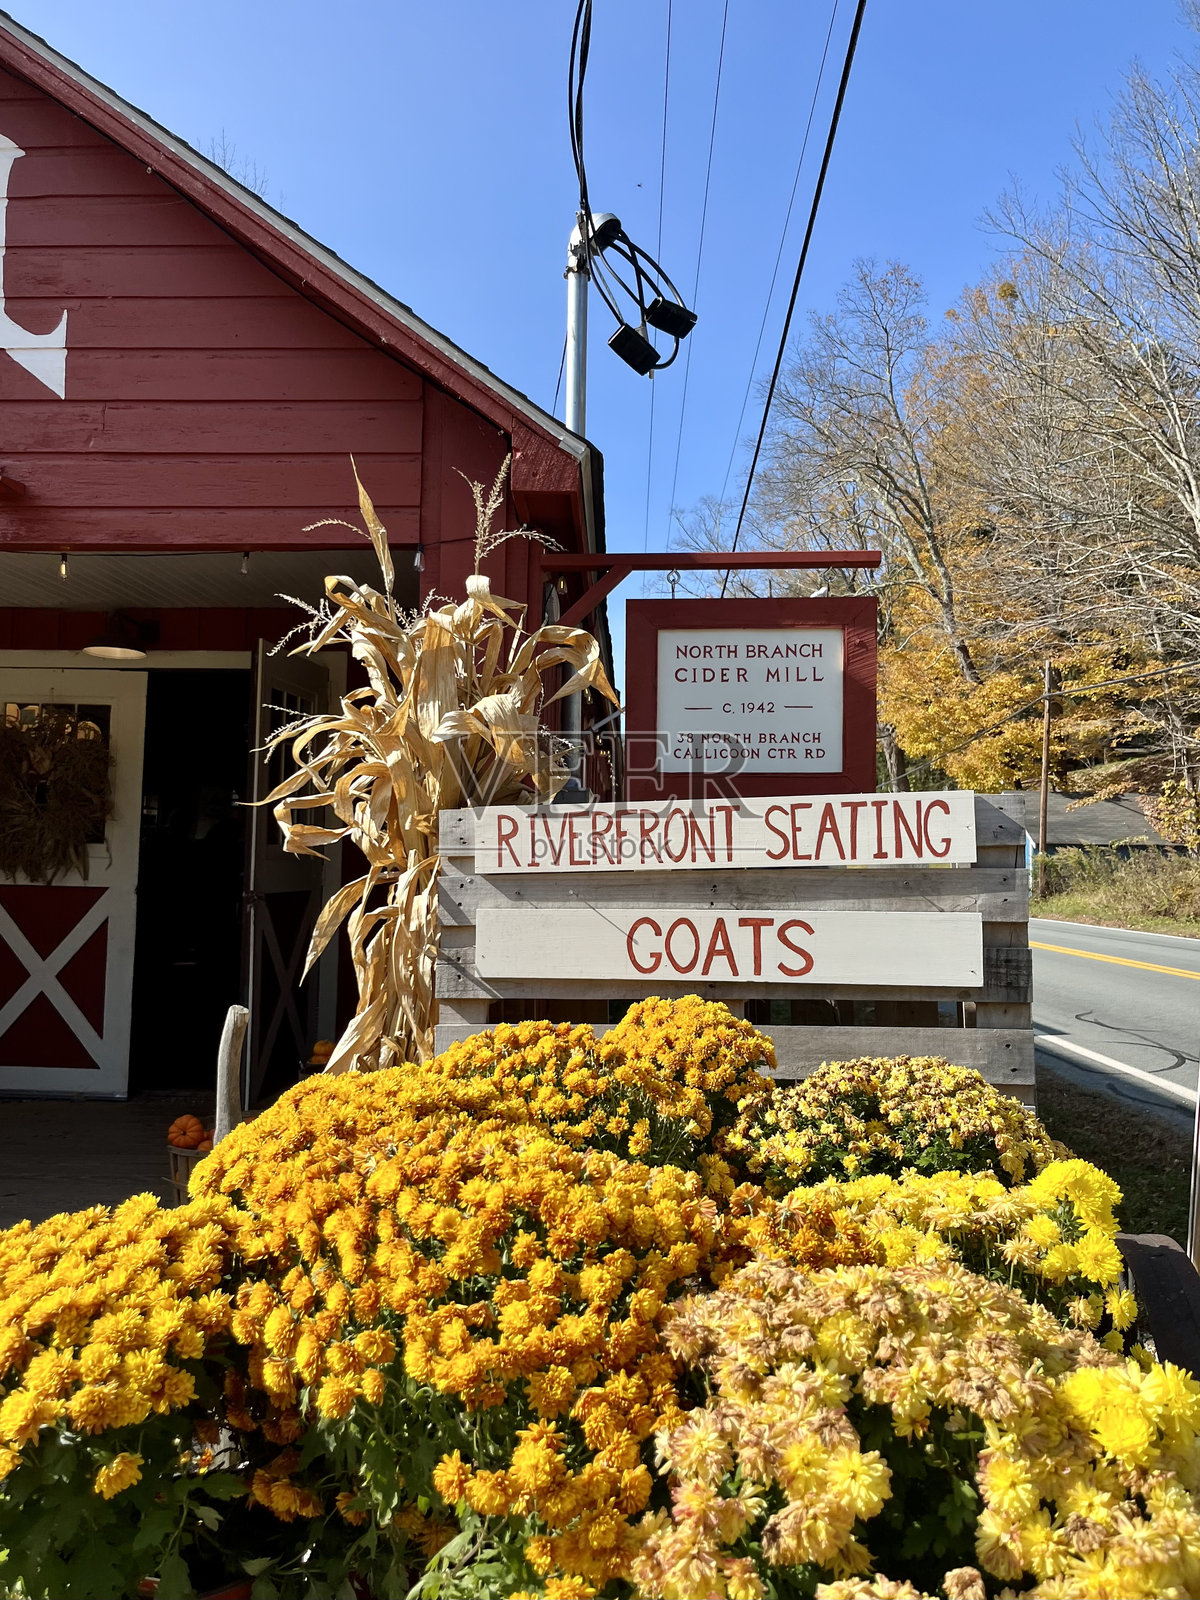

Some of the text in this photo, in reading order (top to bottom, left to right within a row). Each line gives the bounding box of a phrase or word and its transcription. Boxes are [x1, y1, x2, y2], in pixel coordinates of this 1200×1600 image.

[676, 643, 823, 659] NORTH BRANCH
[674, 666, 825, 683] CIDER MILL
[722, 702, 776, 714] C. 1942
[677, 732, 821, 744] 38 NORTH BRANCH
[673, 748, 826, 760] CALLICOON CTR RD
[497, 799, 952, 868] RIVERFRONT SEATING
[626, 916, 816, 978] GOATS
